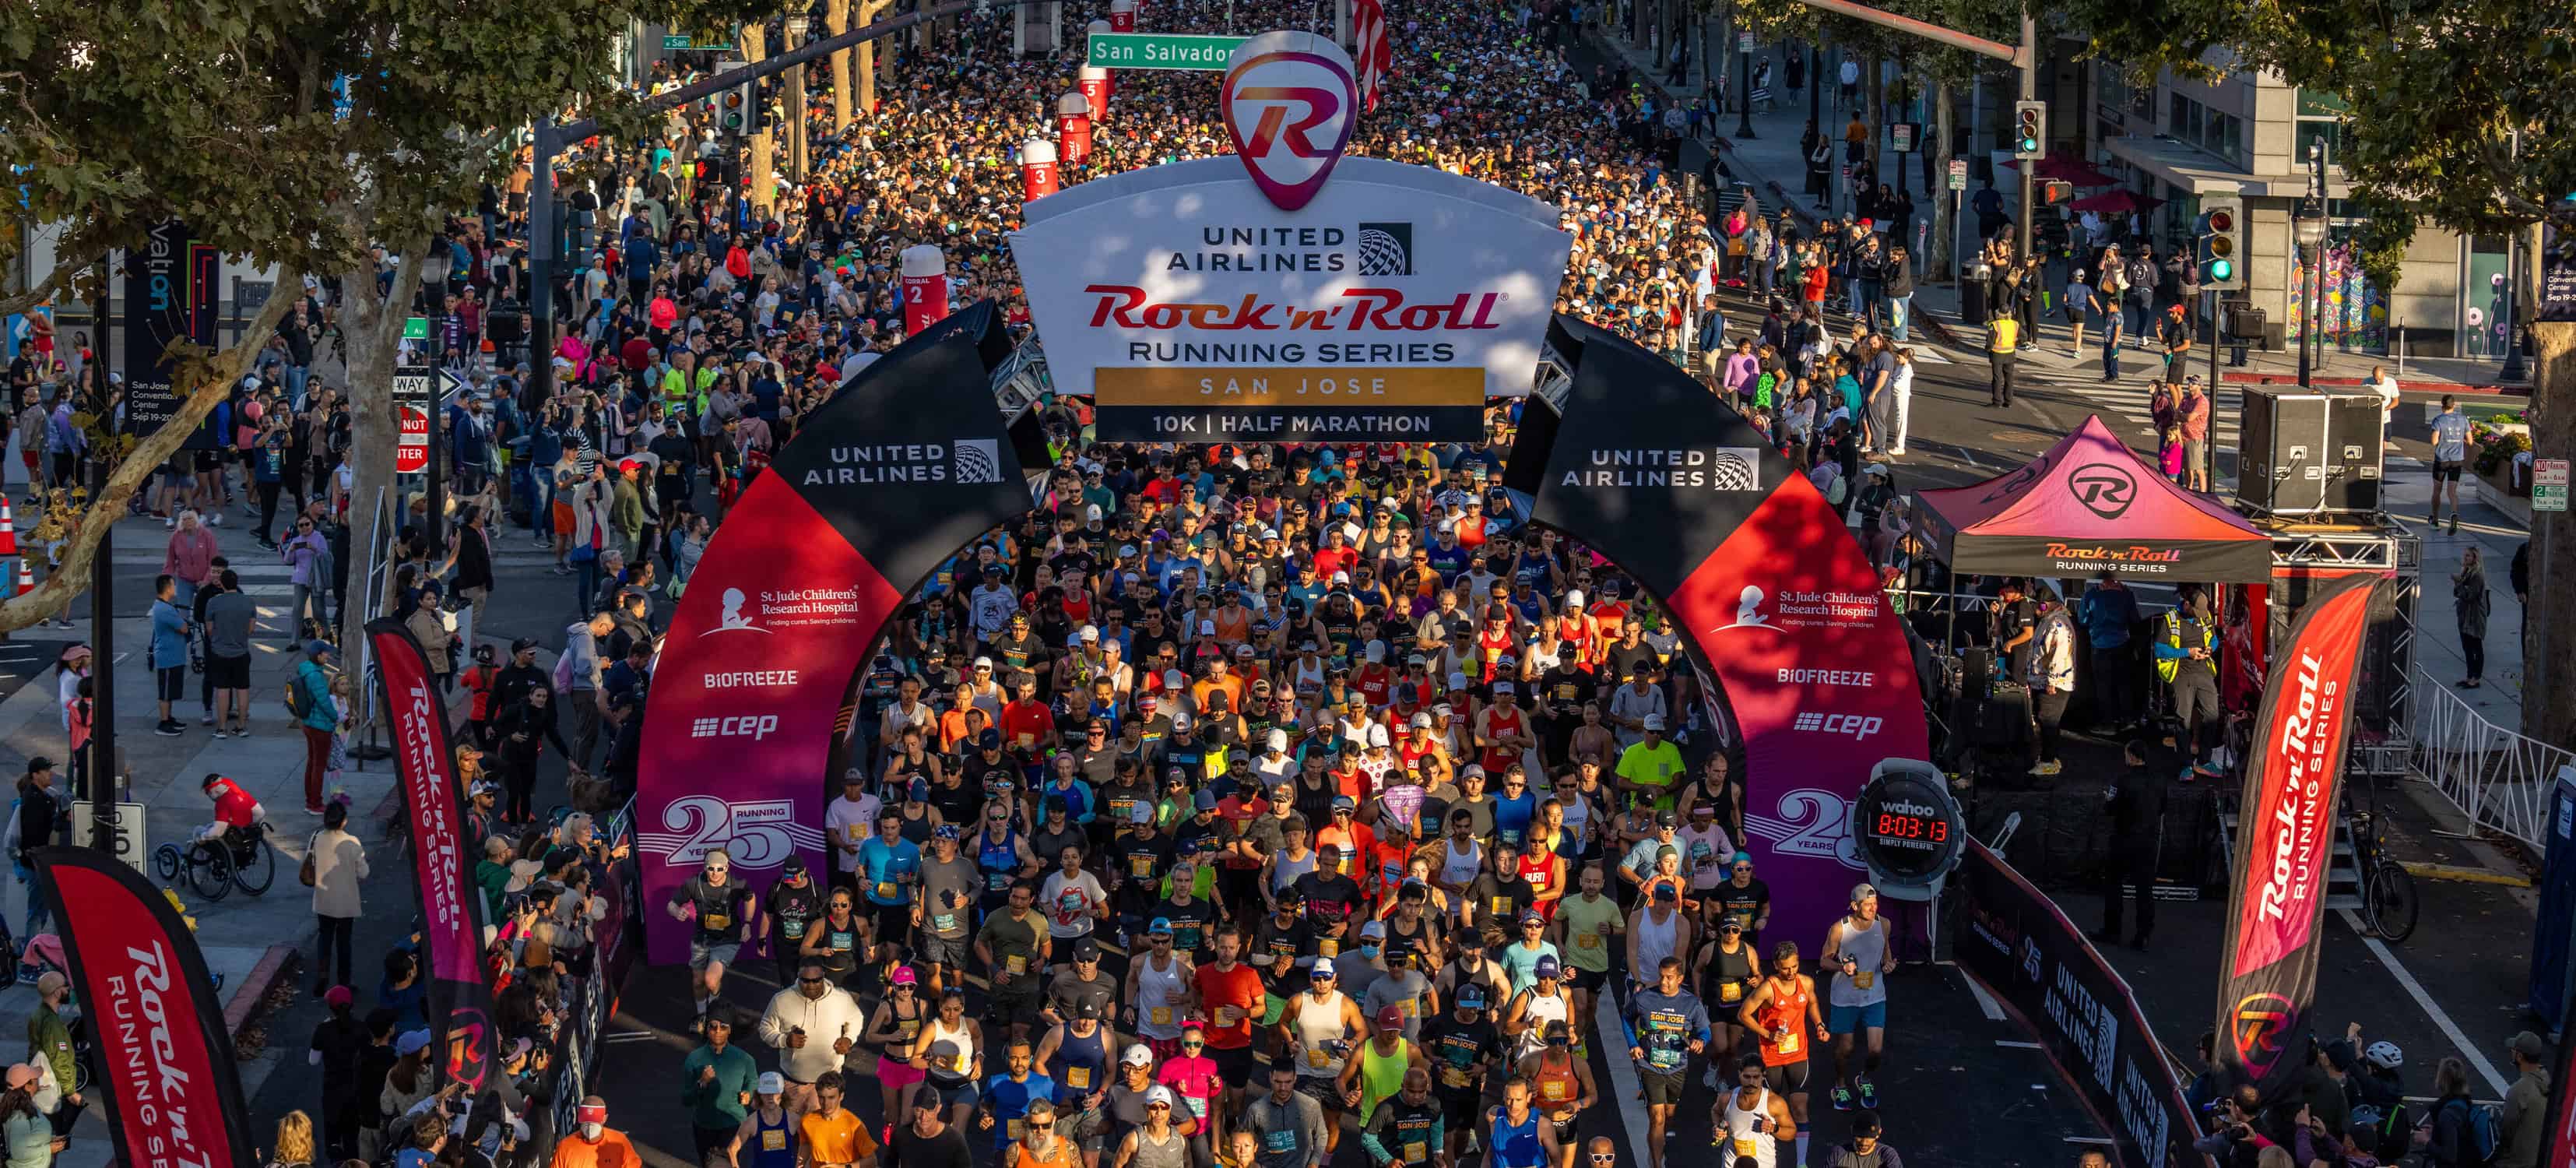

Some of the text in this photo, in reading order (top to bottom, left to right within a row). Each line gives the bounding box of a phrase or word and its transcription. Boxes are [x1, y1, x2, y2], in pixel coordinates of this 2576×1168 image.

[1117, 16, 1125, 26] 8
[1095, 41, 1133, 59] San
[1088, 85, 1095, 97] 5
[1065, 120, 1074, 132] 4
[1035, 170, 1046, 184] 3
[1204, 227, 1344, 246] UNITED
[1167, 252, 1344, 272] AIRLINES
[910, 286, 923, 304] 2
[1084, 285, 1280, 330] Rock
[1342, 288, 1500, 331] Roll
[1130, 342, 1454, 363] RUNNING SERIES
[132, 381, 148, 389] San
[397, 379, 423, 391] WAY
[1200, 378, 1386, 395] SAN JOSE
[132, 400, 159, 409] Center
[132, 412, 149, 422] Sep
[403, 420, 426, 430] NOT
[1154, 415, 1431, 432] 10K HALF MARATHON
[831, 445, 944, 463] UNITED
[1592, 449, 1705, 466] UNITED
[2536, 461, 2546, 471] NO
[803, 465, 946, 486] AIRLINES
[1562, 470, 1705, 487] AIRLINES
[2536, 487, 2543, 497] 2
[2045, 543, 2111, 559] Rock
[2129, 547, 2180, 562] Roll
[2056, 561, 2167, 573] RUNNING SERIES
[761, 589, 857, 603] St. Jude Children's
[1780, 591, 1878, 604] St. Jude Children's
[762, 601, 858, 614] Research Hospital
[1780, 604, 1878, 618] Research Hospital
[705, 670, 797, 688] BiOFREEZE
[1777, 668, 1872, 686] BiOFREEZE
[721, 715, 778, 741] cep
[1823, 714, 1882, 741] cep
[410, 677, 441, 804] Rock
[2258, 796, 2297, 922] Rock
[2282, 653, 2322, 755] Roll
[2293, 681, 2336, 899] RUNNING SERIES
[736, 808, 785, 818] RUNNING
[1881, 800, 1934, 817] wahoo
[403, 712, 448, 923] RUNNING SERIES
[662, 795, 796, 869] 25
[1797, 840, 1833, 851] YEARS
[1879, 838, 1934, 851] SIMPLY POWERFUL
[2024, 936, 2042, 982] 25
[2057, 962, 2097, 1028] UNITED
[127, 939, 189, 1103] Rock
[1667, 1015, 1685, 1024] JOSE
[2044, 986, 2093, 1064] AIRLINES
[107, 976, 158, 1126] RUNNING
[2126, 1054, 2157, 1125] UNITED
[2117, 1081, 2153, 1164] AIRLINES
